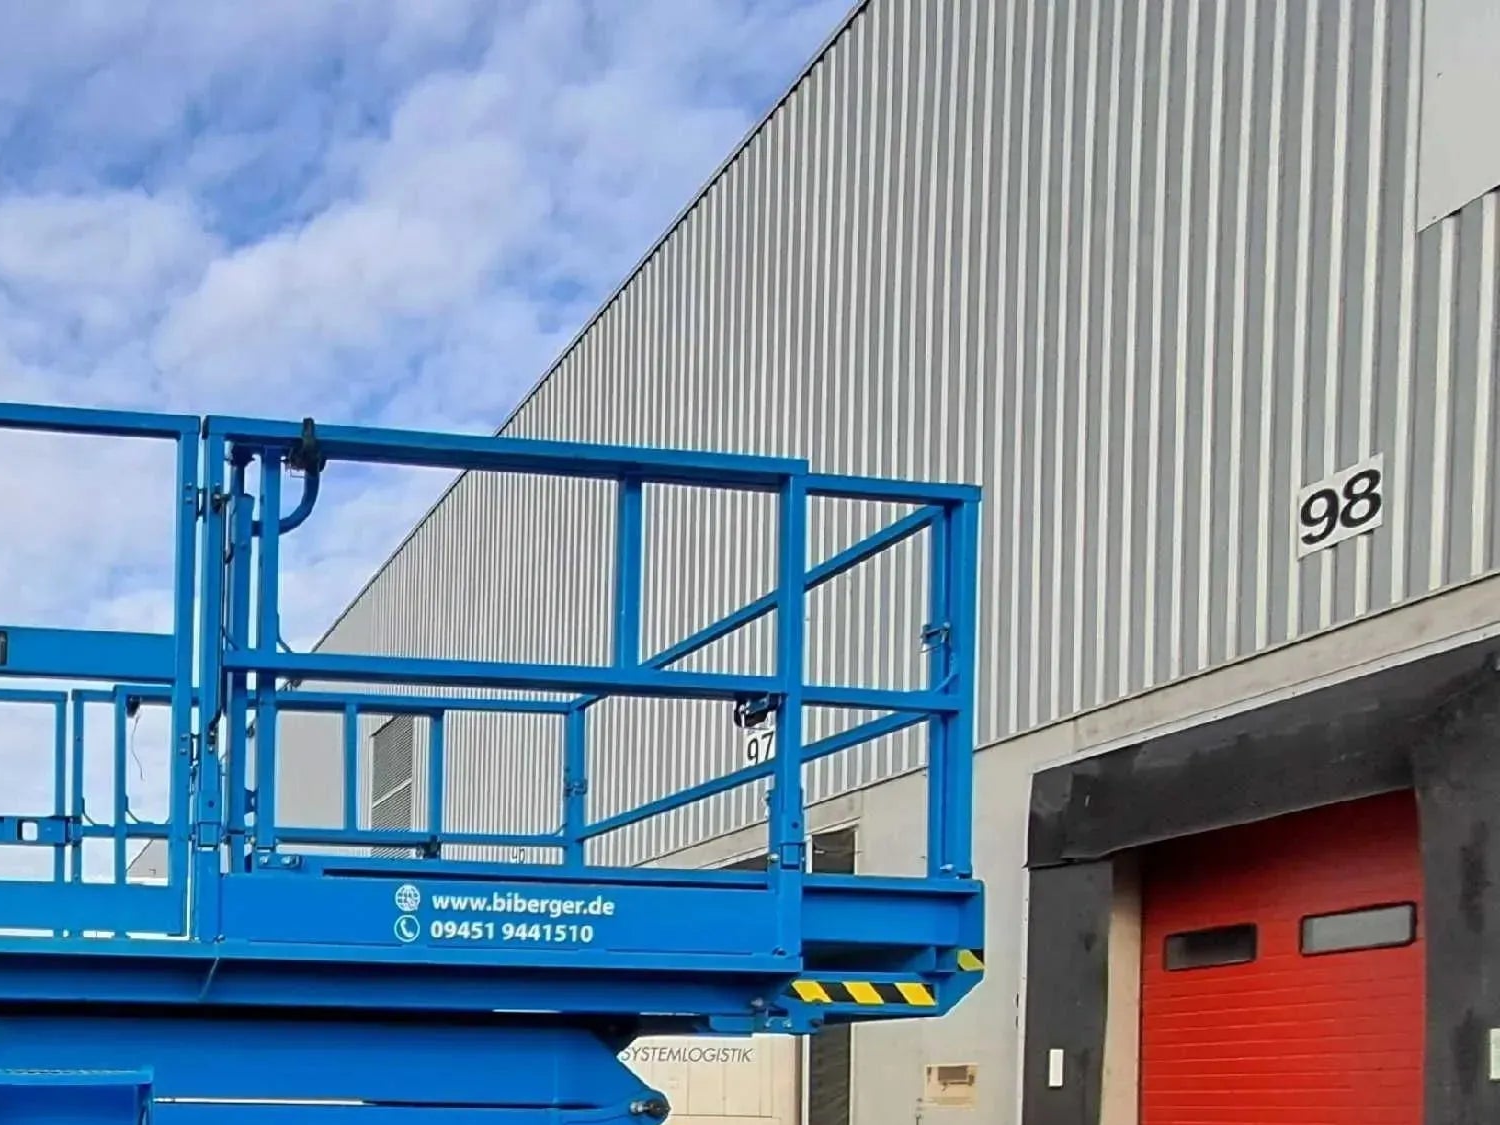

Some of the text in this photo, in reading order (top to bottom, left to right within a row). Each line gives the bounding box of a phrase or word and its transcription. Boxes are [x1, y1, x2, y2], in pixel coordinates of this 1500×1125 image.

[1301, 469, 1381, 545] 98
[747, 731, 776, 764] 97
[432, 892, 615, 918] www.biberger.de
[430, 920, 593, 943] 09451 9441510
[621, 1047, 753, 1063] SYSTEMLOGISTIK
